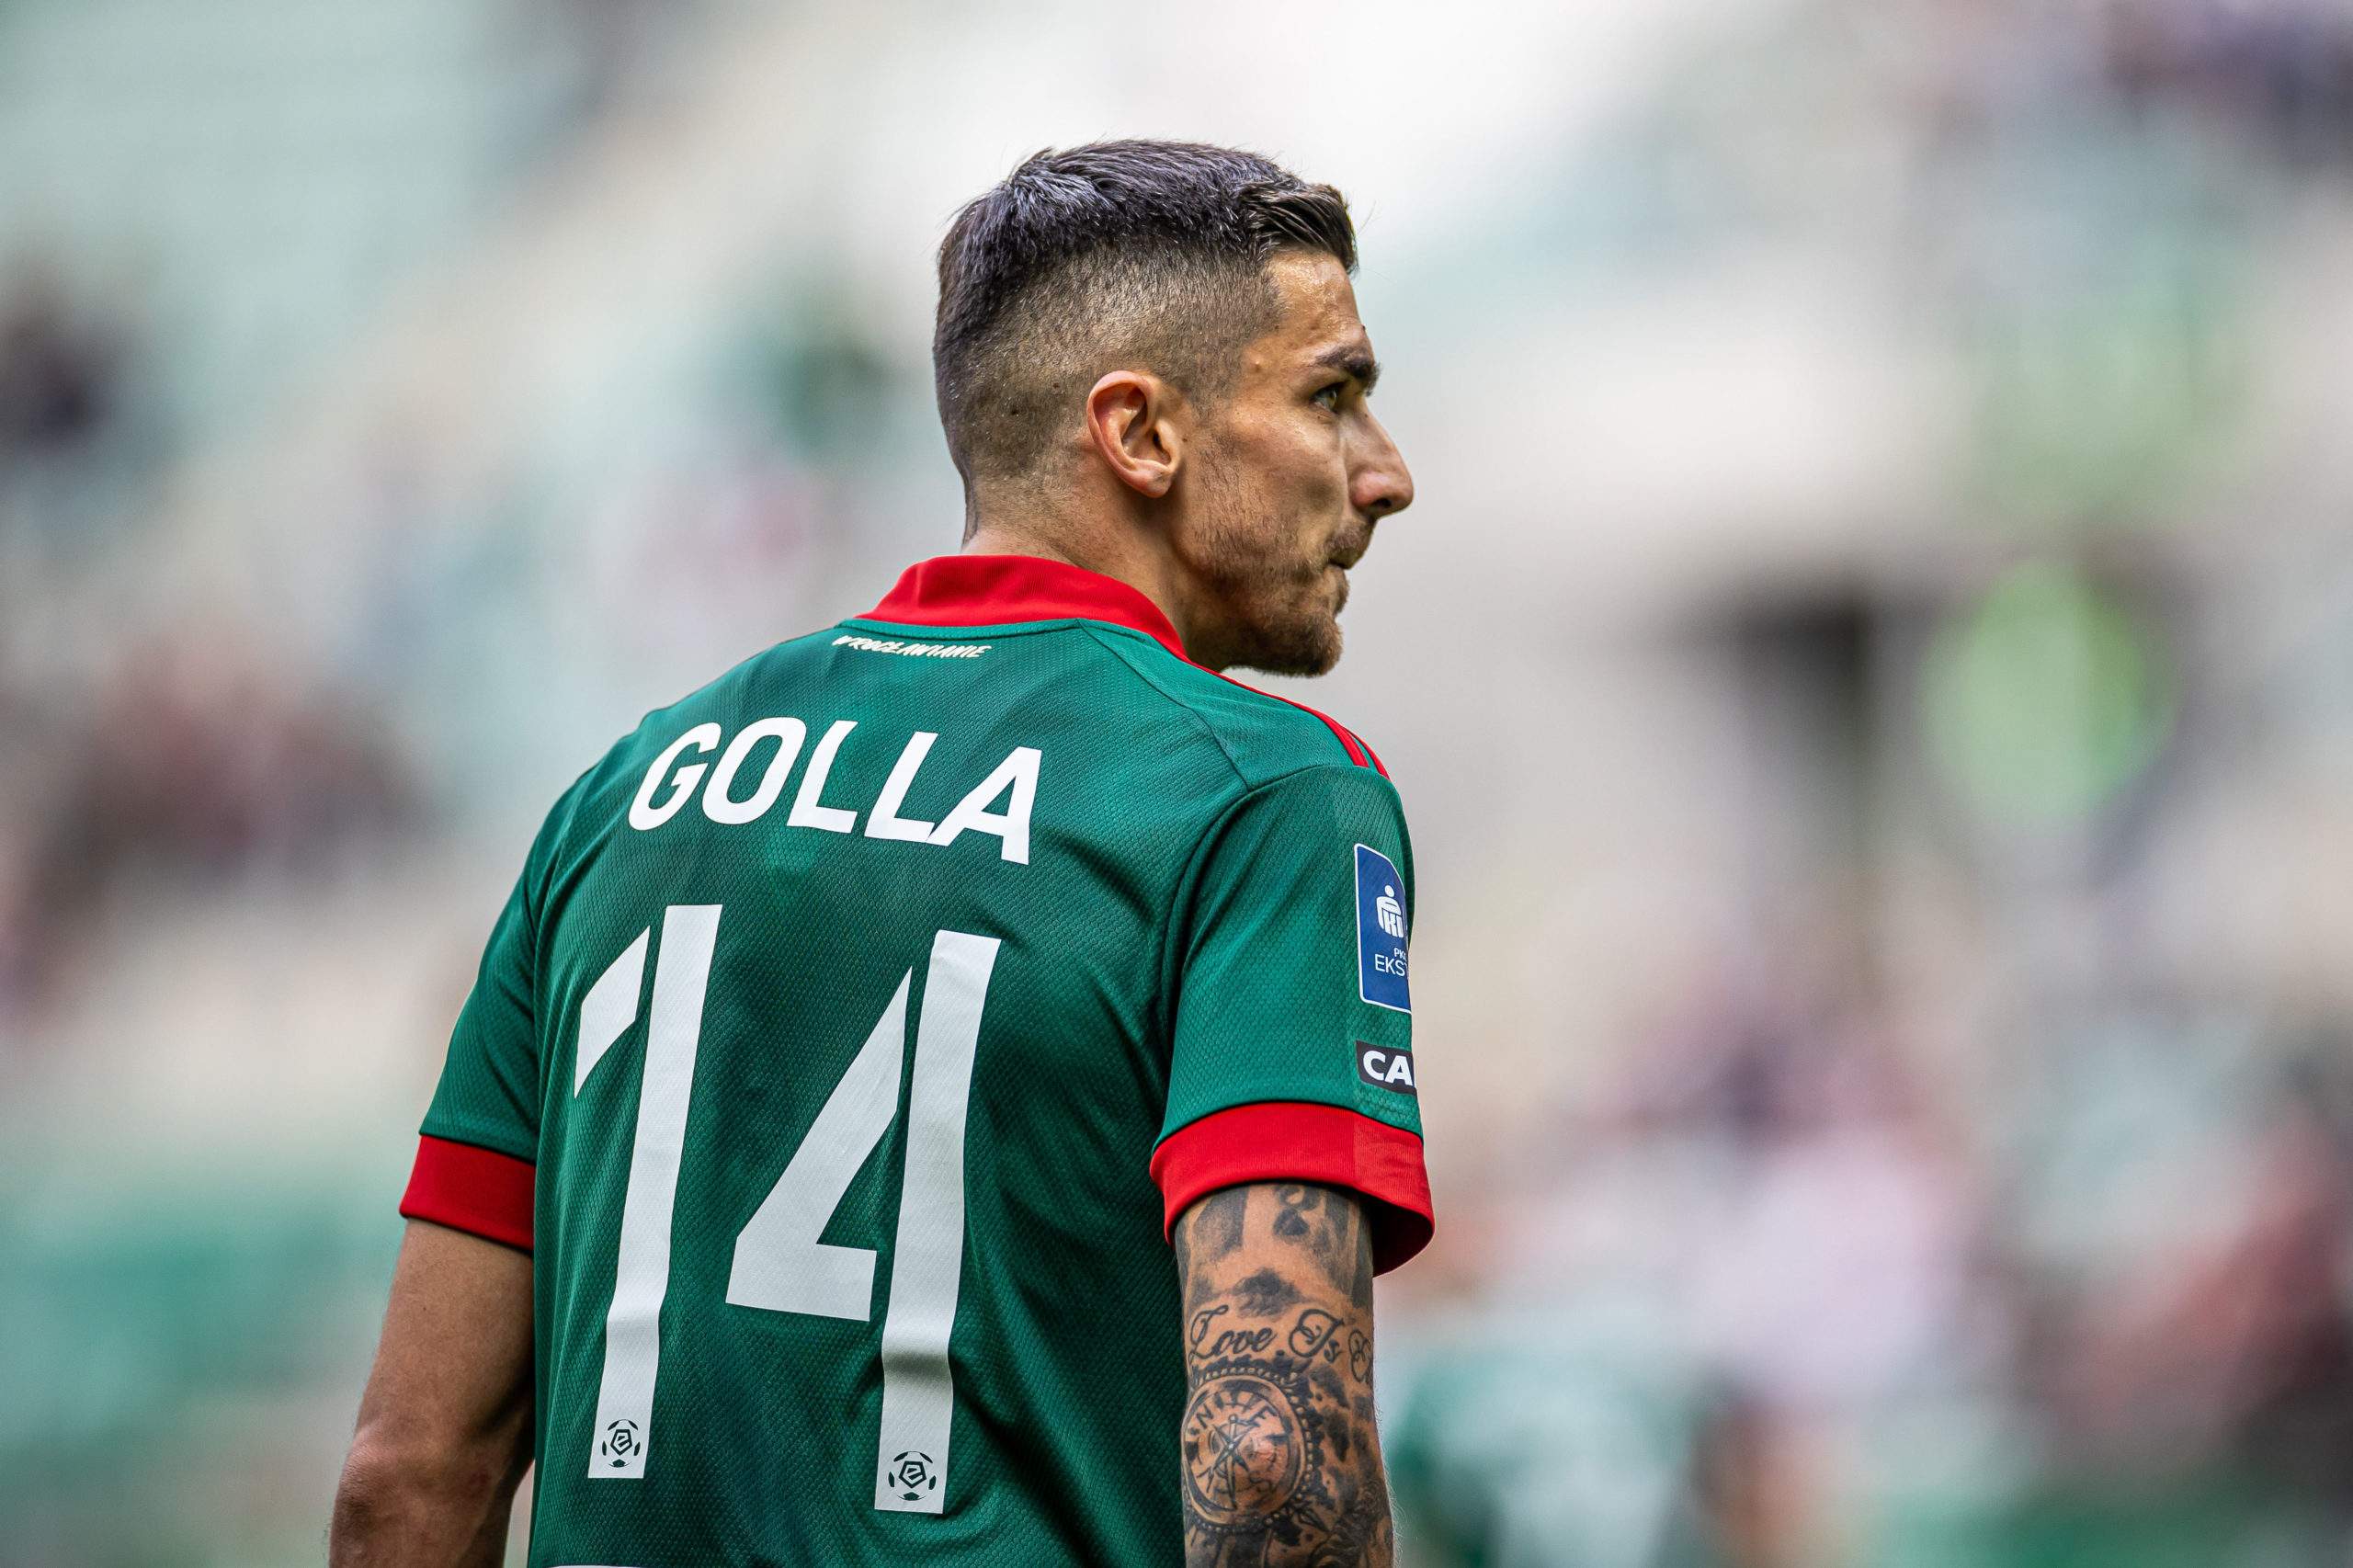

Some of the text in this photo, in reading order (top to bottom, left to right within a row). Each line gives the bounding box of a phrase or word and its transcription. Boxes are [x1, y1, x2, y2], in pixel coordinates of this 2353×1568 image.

[628, 716, 1042, 865] GOLLA
[1363, 1050, 1415, 1087] CA
[574, 904, 1002, 1515] 14
